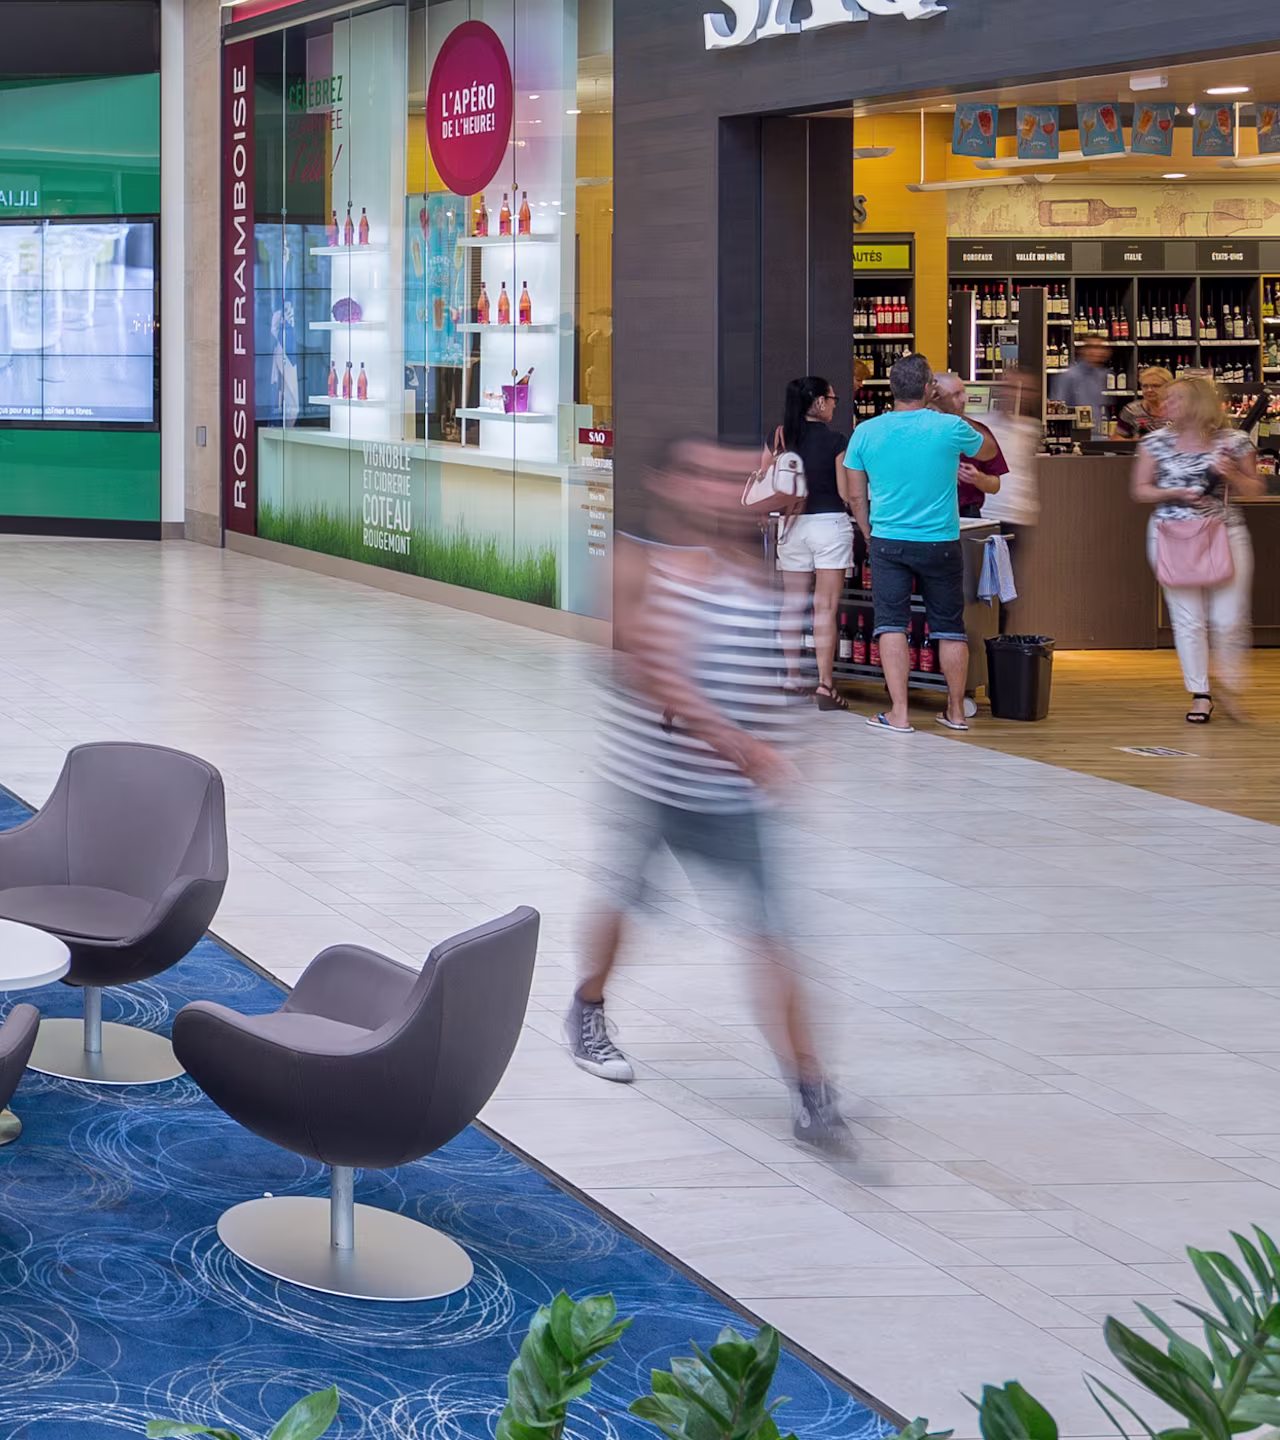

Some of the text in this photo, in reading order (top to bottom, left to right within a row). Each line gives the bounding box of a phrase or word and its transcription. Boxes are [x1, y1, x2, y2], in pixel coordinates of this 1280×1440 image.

[288, 74, 344, 112] CÉLÉBREZ
[442, 80, 496, 118] L'APÉRO
[442, 112, 496, 139] DE L'HEURE!
[962, 253, 993, 262] BORDEAUX
[1124, 252, 1143, 262] ITALIE
[233, 64, 247, 509] ROSE FRAMBOISE
[588, 431, 606, 444] SAQ
[362, 441, 411, 472] VIGNOBLE
[363, 469, 411, 497] ET CIDRERIE
[362, 493, 412, 534] COTEAU
[362, 527, 411, 556] ROUGEMONT
